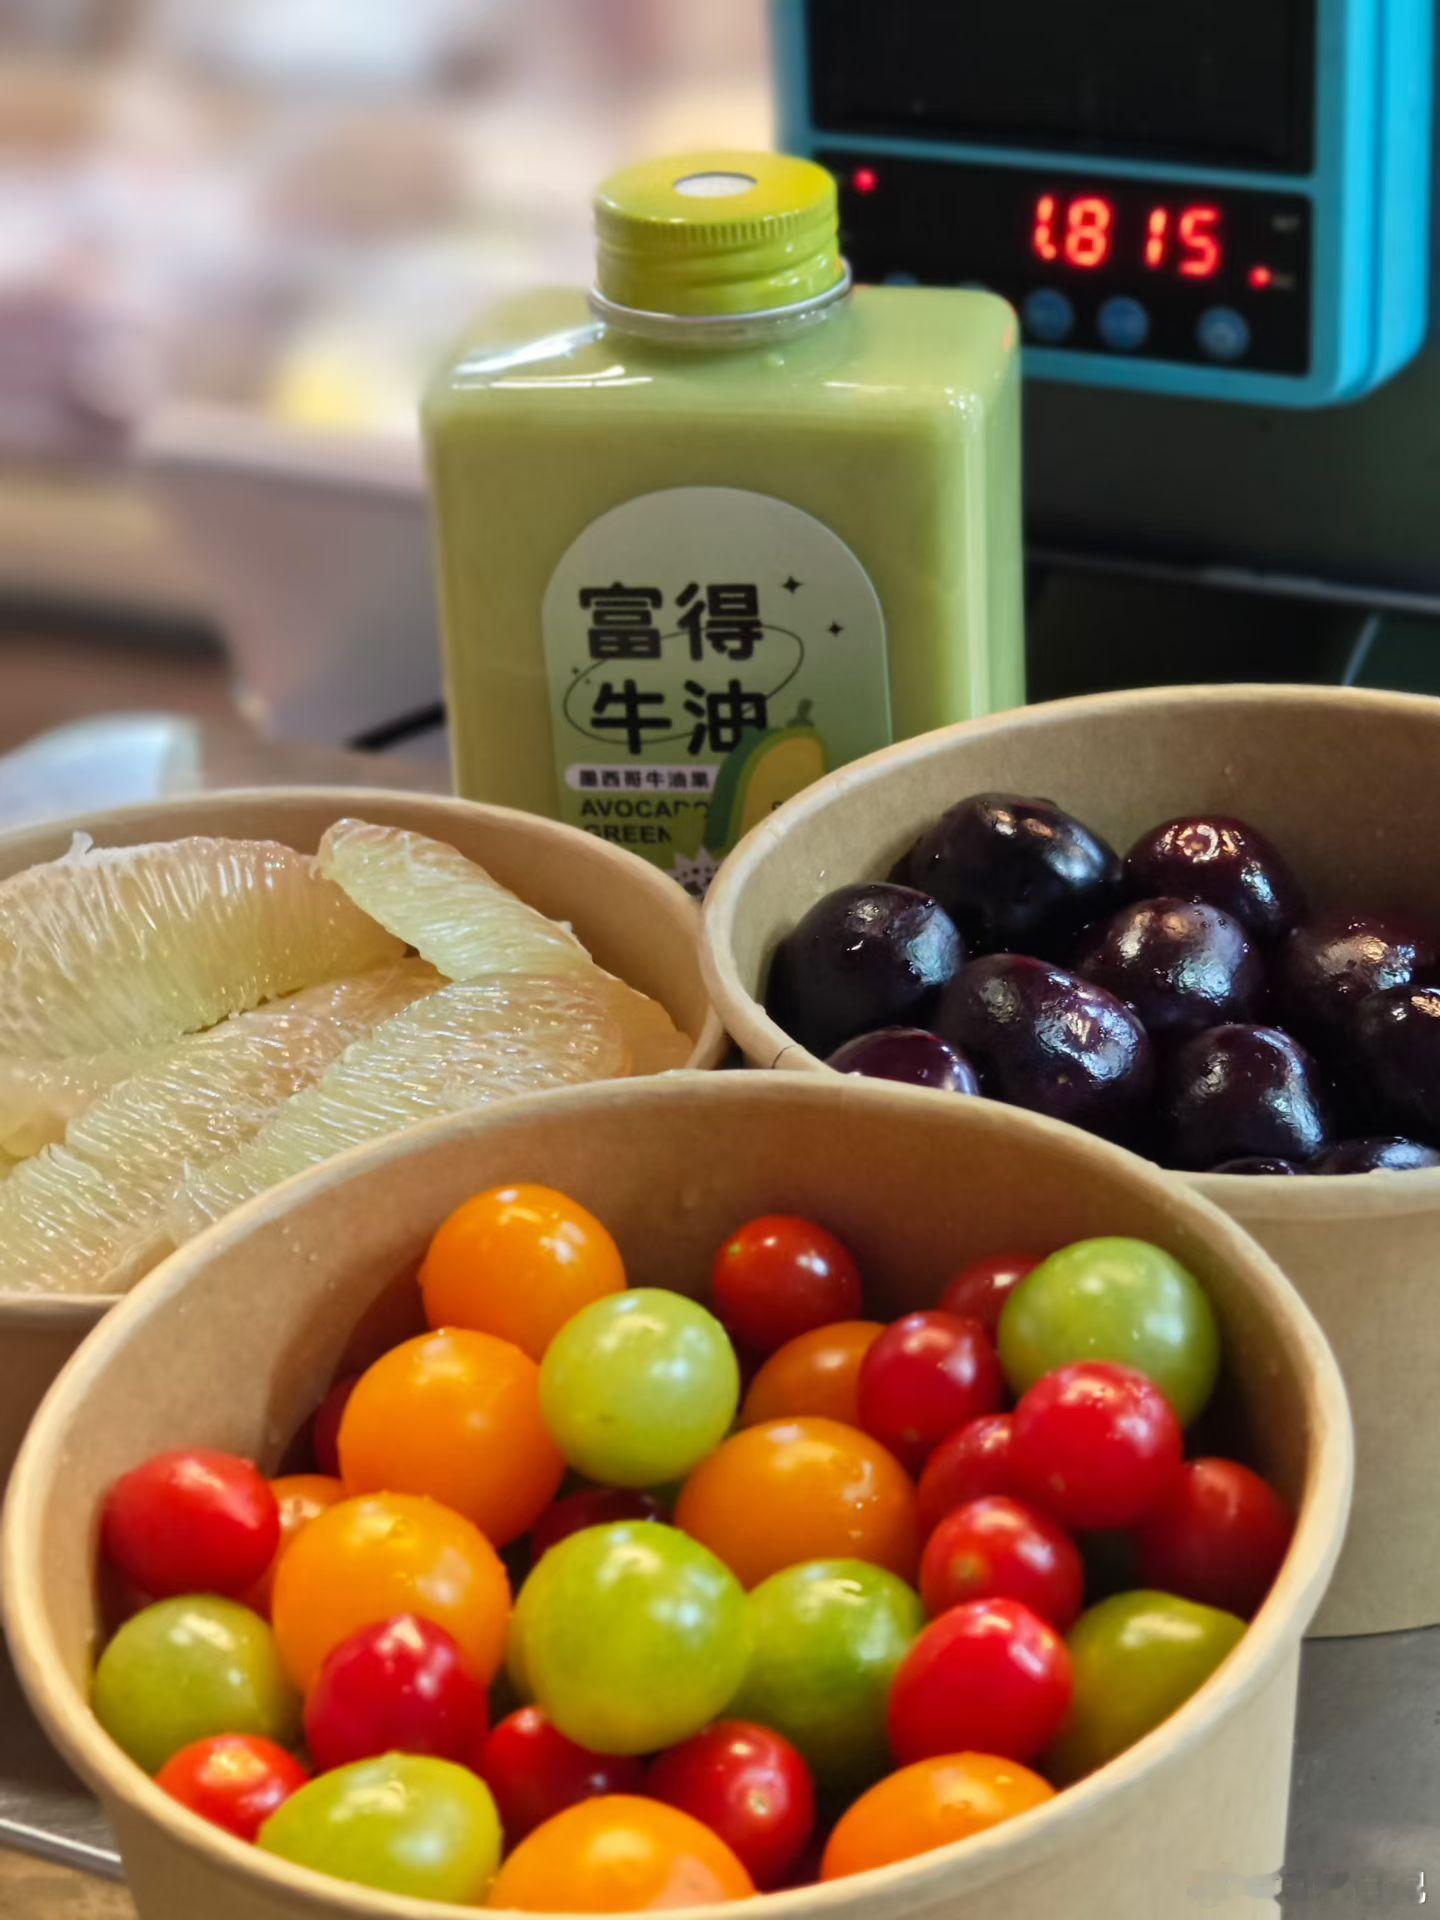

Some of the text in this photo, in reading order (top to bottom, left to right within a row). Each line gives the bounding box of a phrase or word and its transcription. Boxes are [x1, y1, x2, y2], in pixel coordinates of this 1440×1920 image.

[579, 582, 763, 661] 富得
[590, 678, 767, 756] 牛油
[578, 768, 709, 788] 墨西哥牛油果
